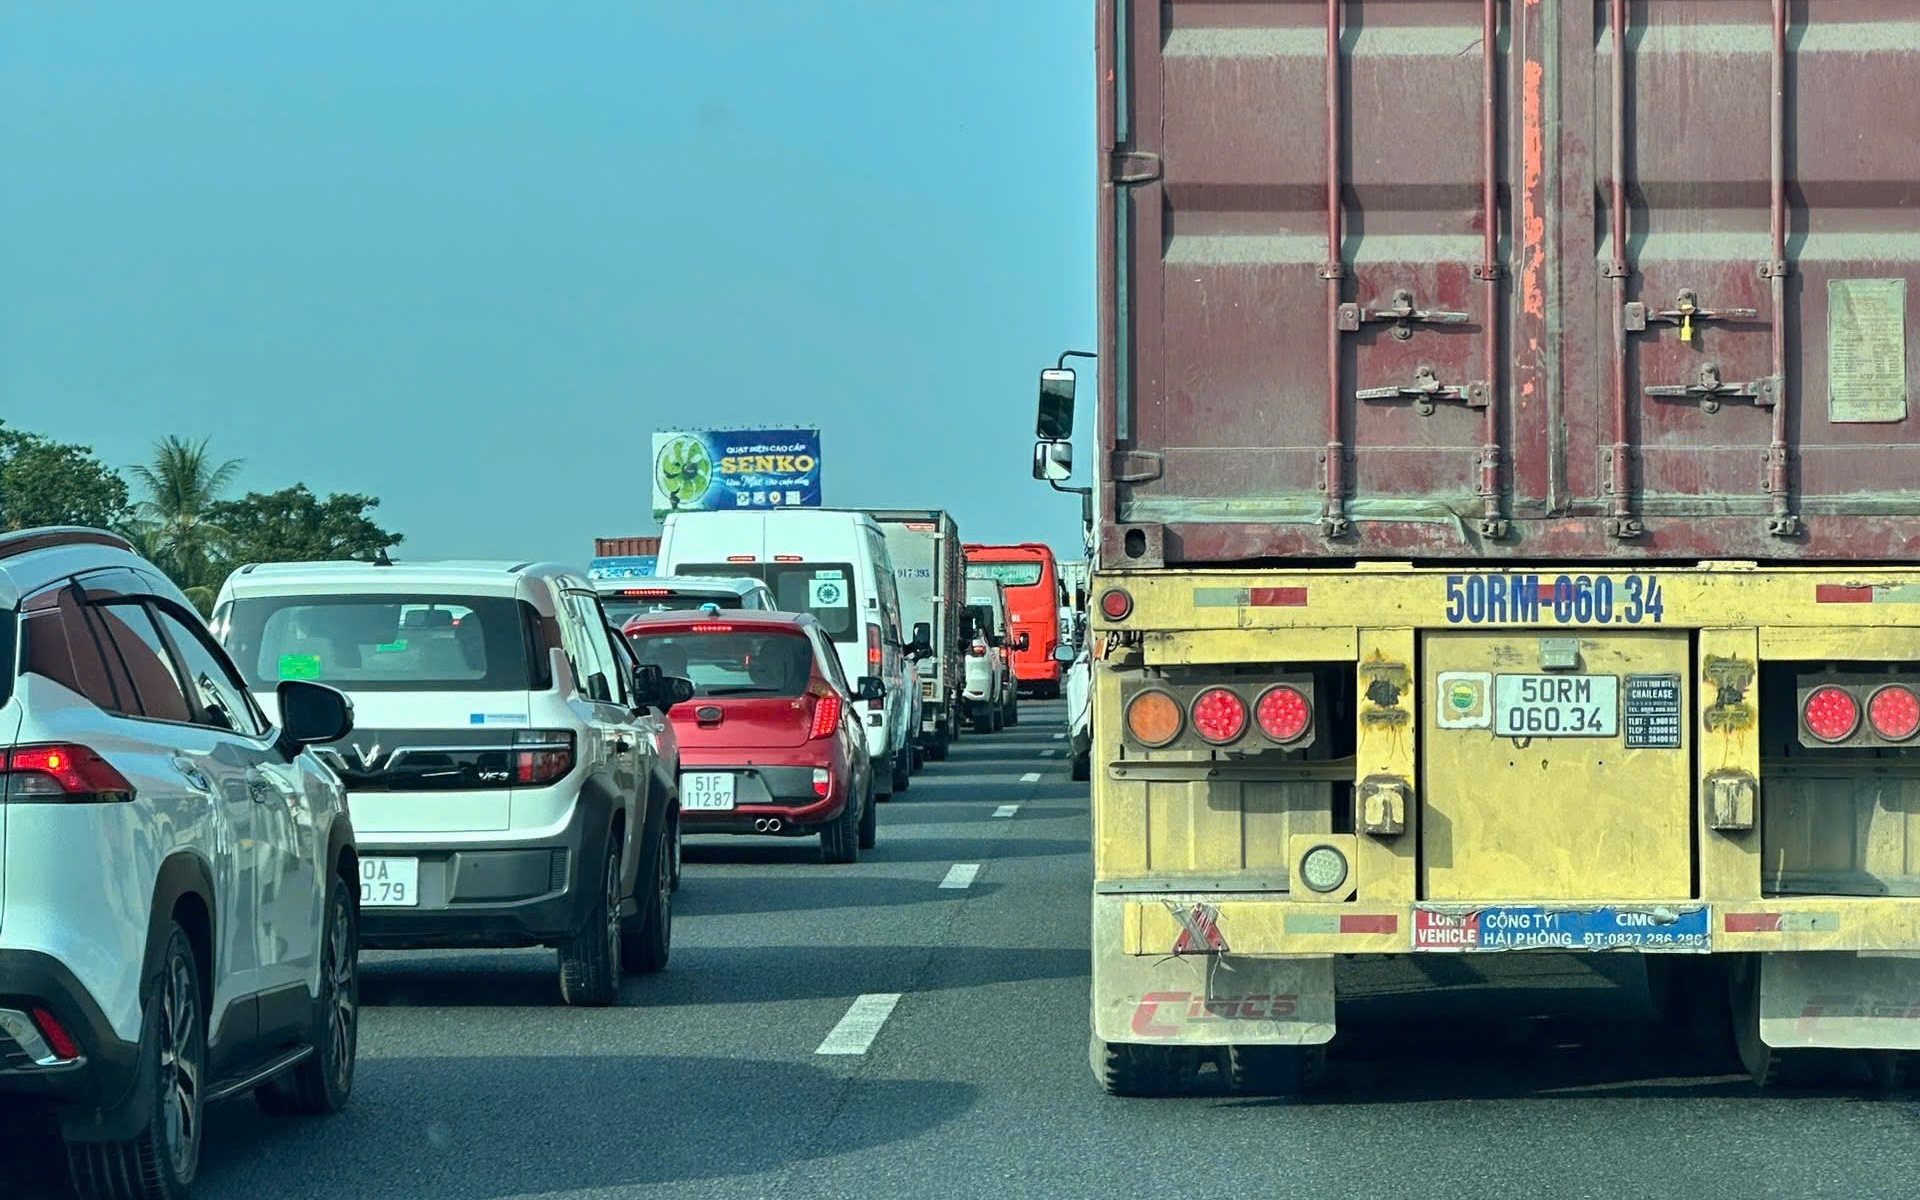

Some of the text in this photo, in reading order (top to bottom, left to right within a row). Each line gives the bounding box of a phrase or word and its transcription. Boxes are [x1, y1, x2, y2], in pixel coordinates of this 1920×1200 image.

[770, 444, 787, 452] CAO
[720, 455, 814, 474] SENKO
[1446, 574, 1664, 624] 50RM-060.34
[1522, 678, 1591, 703] 50RM
[1632, 689, 1673, 699] CHAILEASE
[1509, 707, 1603, 732] 060.34
[695, 776, 721, 791] 51F
[358, 860, 388, 880] 0A
[359, 882, 405, 902] 0.79
[1486, 911, 1553, 929] CÔNG TY
[1418, 928, 1477, 944] VEHICLE
[1516, 930, 1572, 945] PHÒNG
